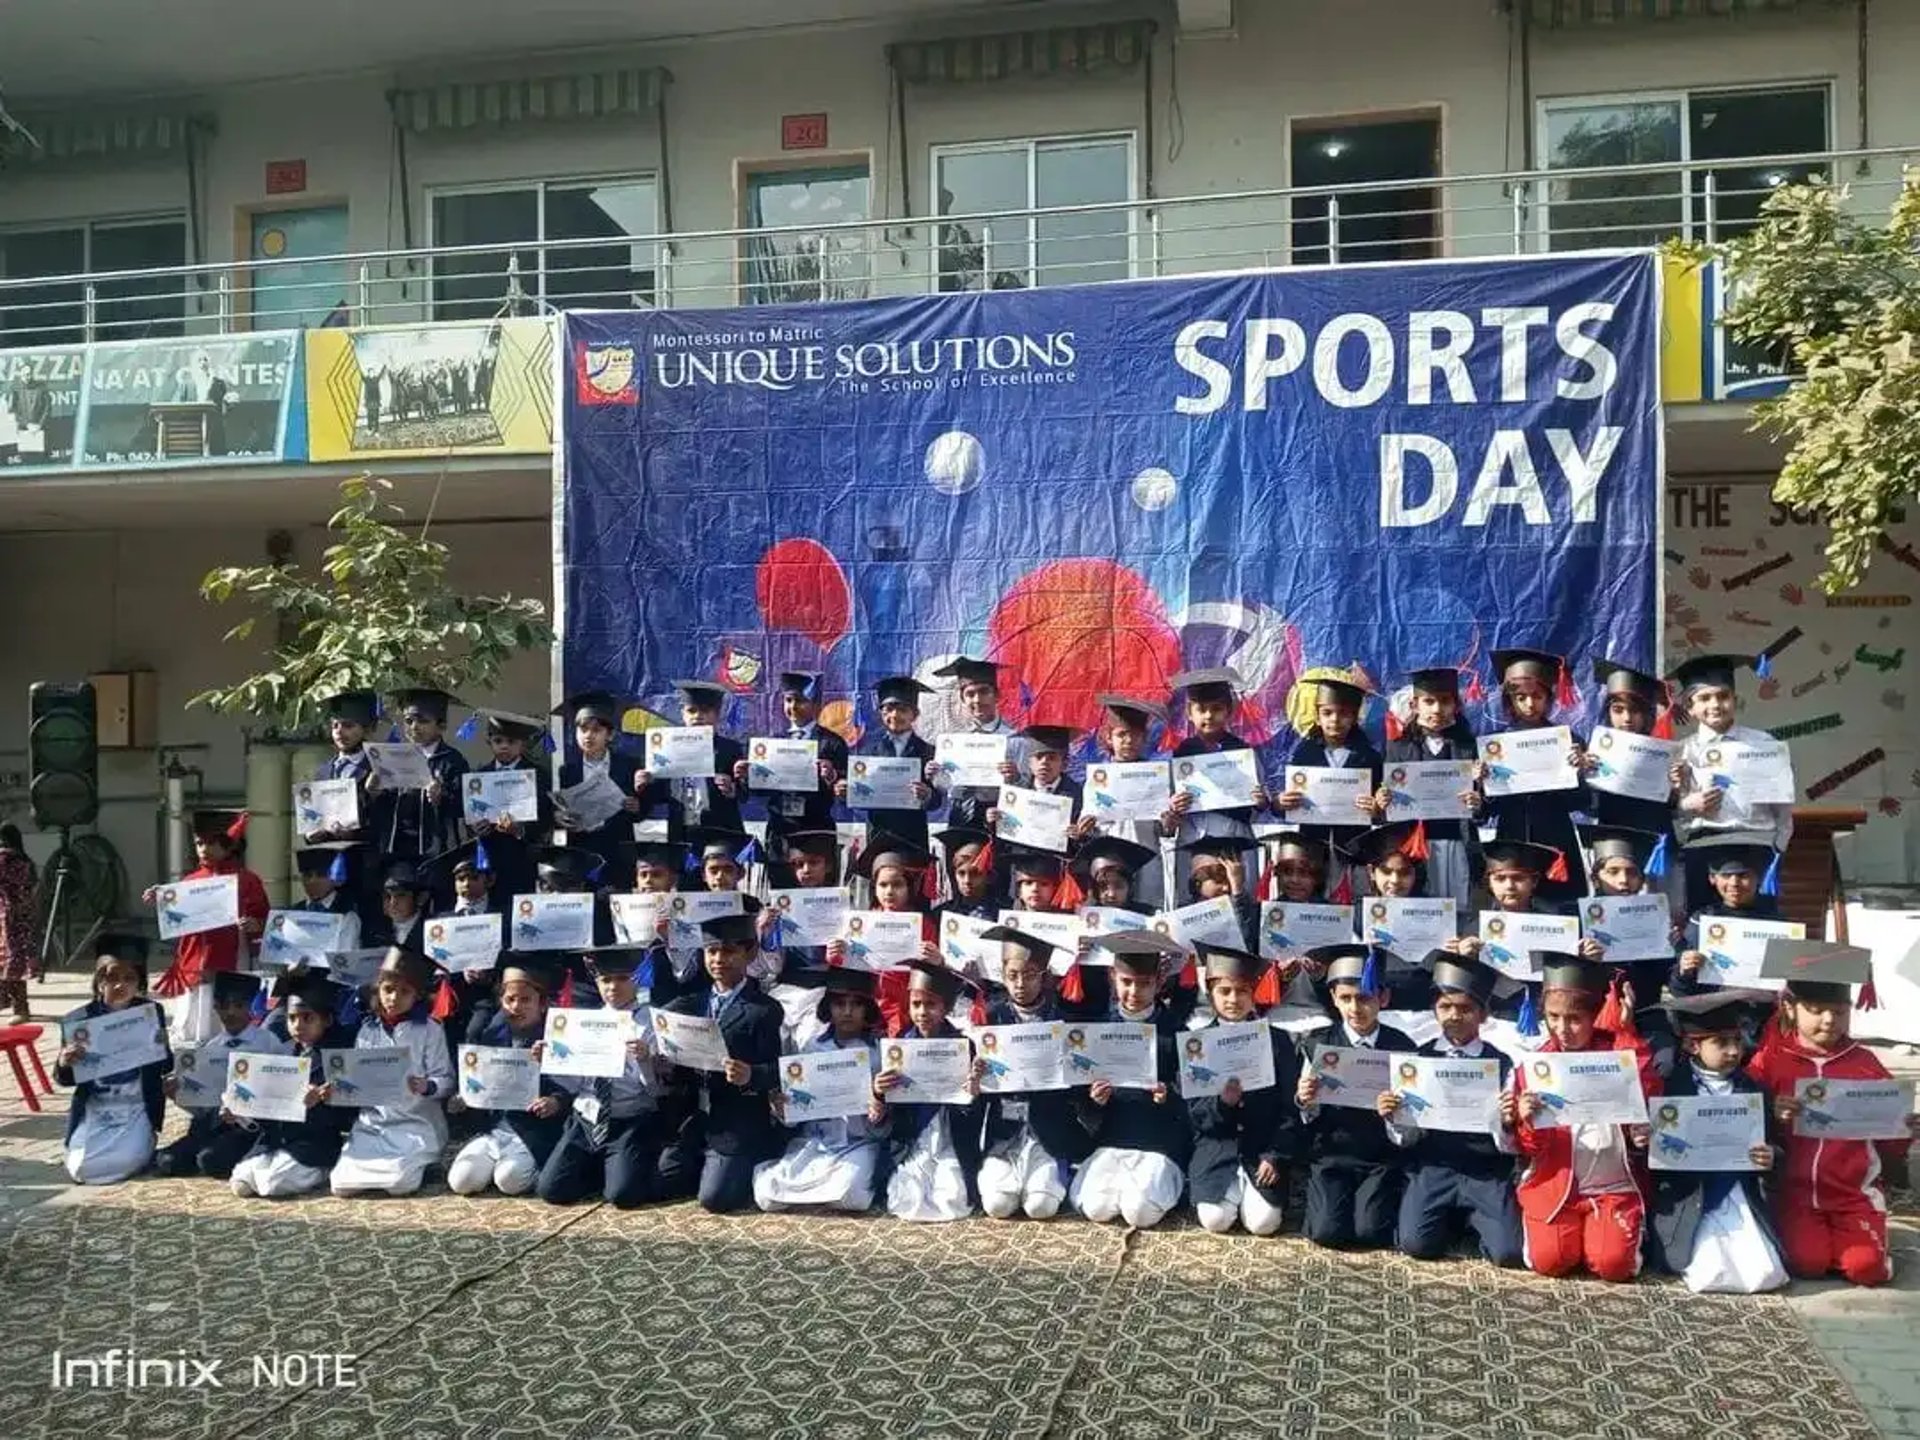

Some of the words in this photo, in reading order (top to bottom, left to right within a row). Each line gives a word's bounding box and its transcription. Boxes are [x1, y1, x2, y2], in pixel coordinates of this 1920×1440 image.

[654, 332, 745, 348] Montessori
[749, 330, 766, 343] to
[770, 327, 823, 342] Matric
[1174, 301, 1618, 415] SPORTS
[655, 346, 825, 391] UNIQUE
[835, 332, 1077, 378] SOLUTIONS
[841, 379, 868, 393] The
[881, 376, 942, 392] School
[951, 374, 968, 388] of
[980, 370, 1076, 388] Excellence
[1380, 426, 1625, 528] DAY
[1668, 486, 1731, 528] THE
[1697, 1107, 1748, 1118] CERTIFICATE
